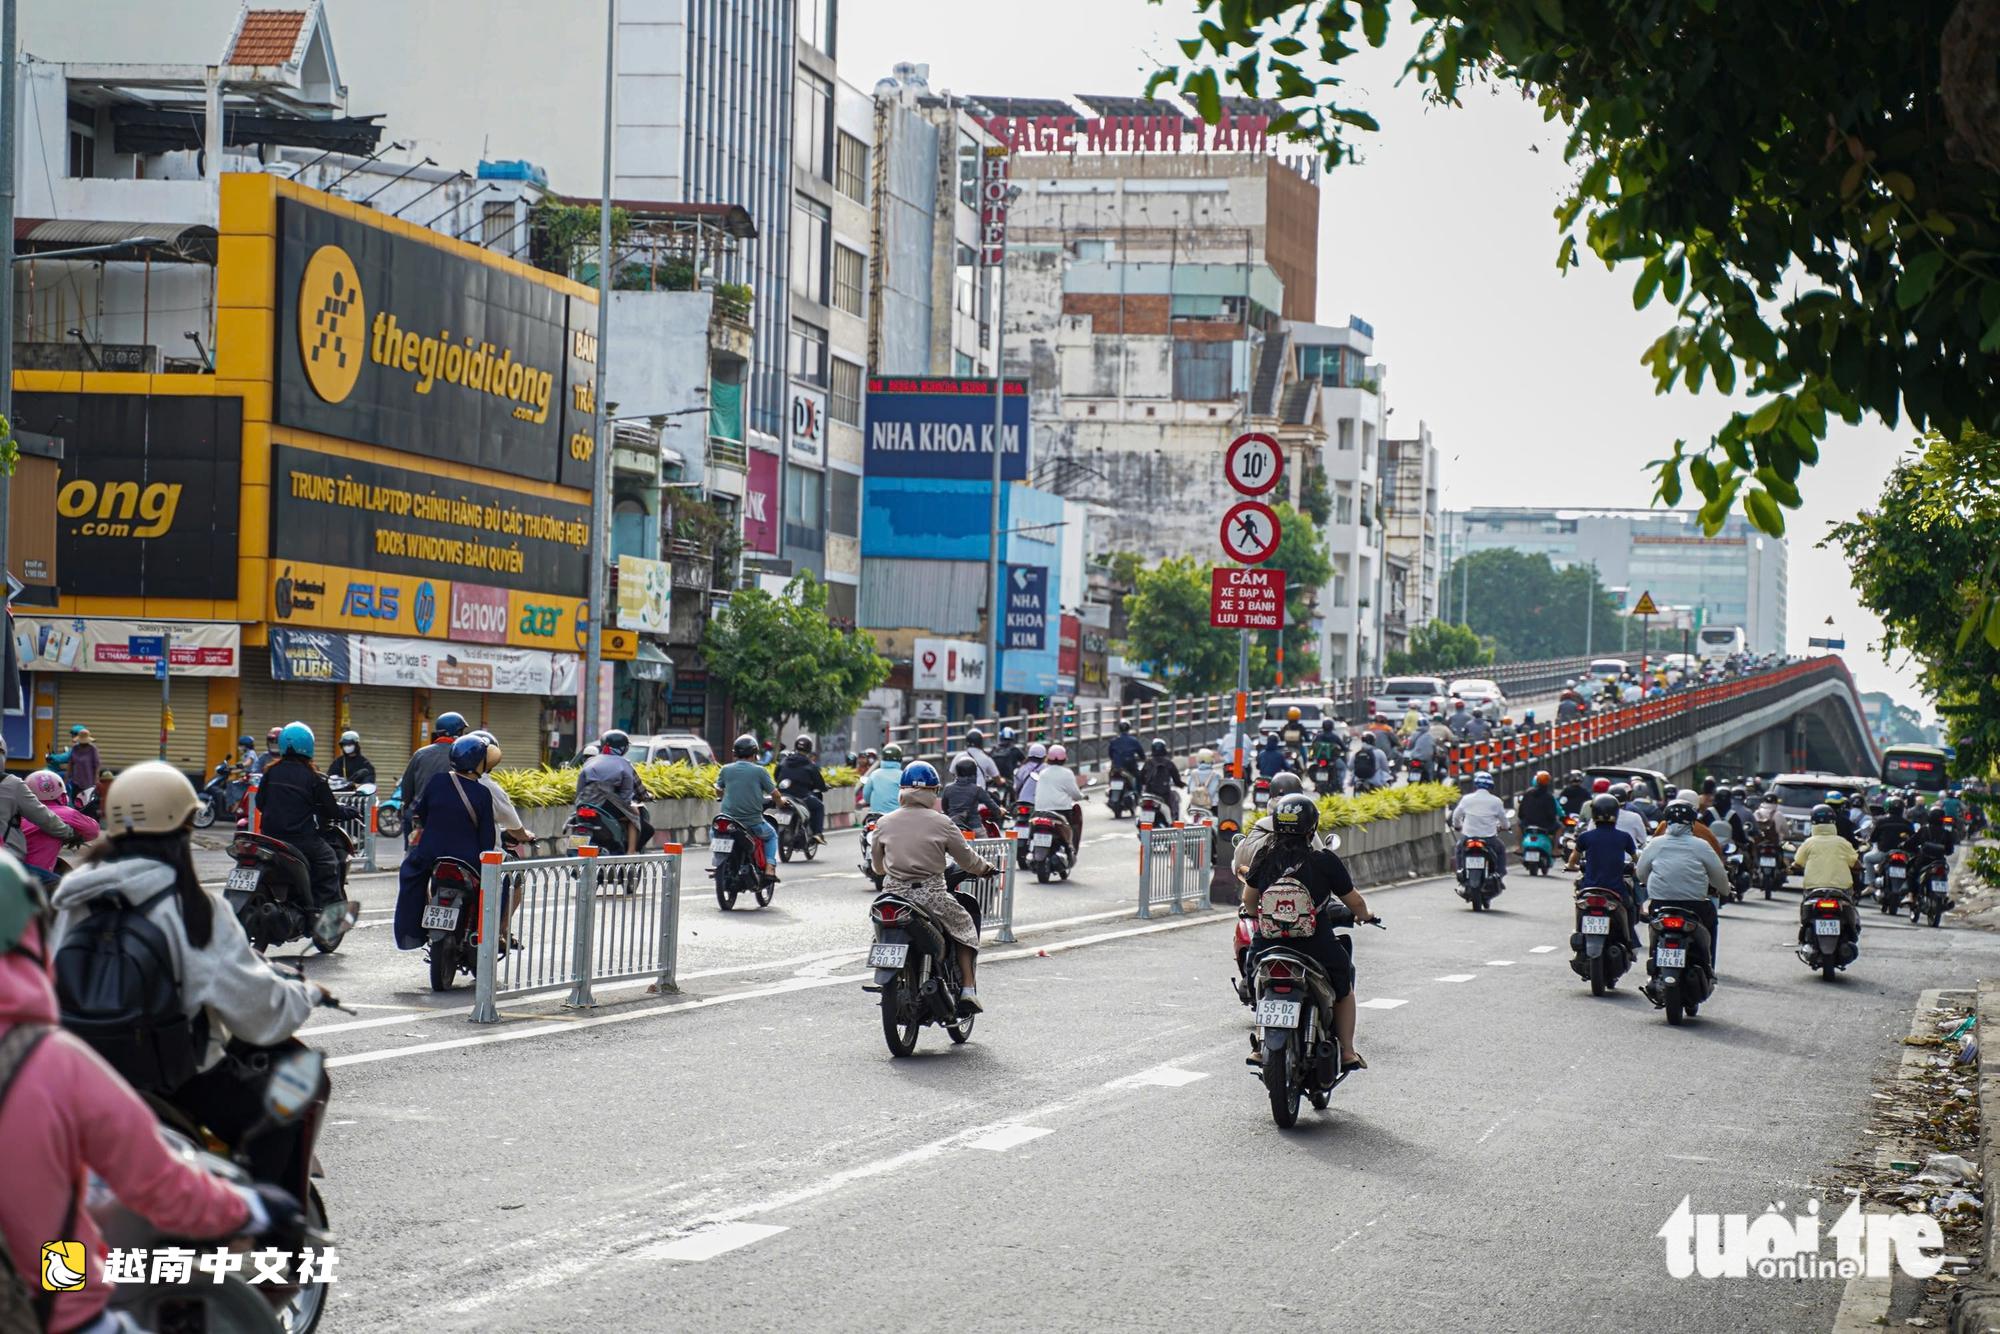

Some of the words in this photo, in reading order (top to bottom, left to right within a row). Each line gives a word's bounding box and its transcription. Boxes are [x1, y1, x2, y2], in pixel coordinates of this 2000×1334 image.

[1088, 115, 1183, 151] MINH
[984, 161, 1005, 265] HOTEL
[371, 312, 553, 424] thegioididong
[573, 380, 595, 415] TRẢ
[512, 407, 534, 422] .com
[571, 428, 594, 461] GÓP
[872, 422, 915, 450] NHA
[919, 423, 977, 452] KHOA
[981, 424, 1019, 453] KM
[57, 469, 183, 538] ong
[290, 471, 335, 503] TRUNG
[337, 474, 363, 508] TÂM
[365, 485, 411, 515] LAPTOP
[413, 490, 450, 522] CHÍNH
[452, 496, 482, 528] HÀNG
[484, 500, 501, 532] ĐỦ
[502, 506, 523, 535] CÁC
[525, 514, 565, 543] THƯƠNG
[566, 517, 589, 551] HIỆU
[71, 522, 130, 537] .com
[376, 528, 405, 556] 100%
[407, 533, 464, 565] WINDOWS
[465, 536, 487, 567] BẢN
[489, 541, 524, 573] QUYỀN
[1221, 587, 1235, 597] XE
[1239, 588, 1259, 599] ĐẠP
[1263, 587, 1275, 599] VÀ
[1230, 568, 1268, 585] CẤM
[341, 583, 399, 621] ASUS
[452, 593, 506, 633] Lenovo
[1012, 594, 1040, 608] NHA
[1220, 600, 1233, 610] XE
[1238, 601, 1245, 611] 3
[1248, 600, 1275, 612] BÁNH
[520, 604, 562, 637] acer
[1007, 613, 1043, 627] KHOA
[1217, 613, 1238, 624] LƯU
[1244, 613, 1277, 626] THÔNG
[1012, 633, 1037, 647] KIM
